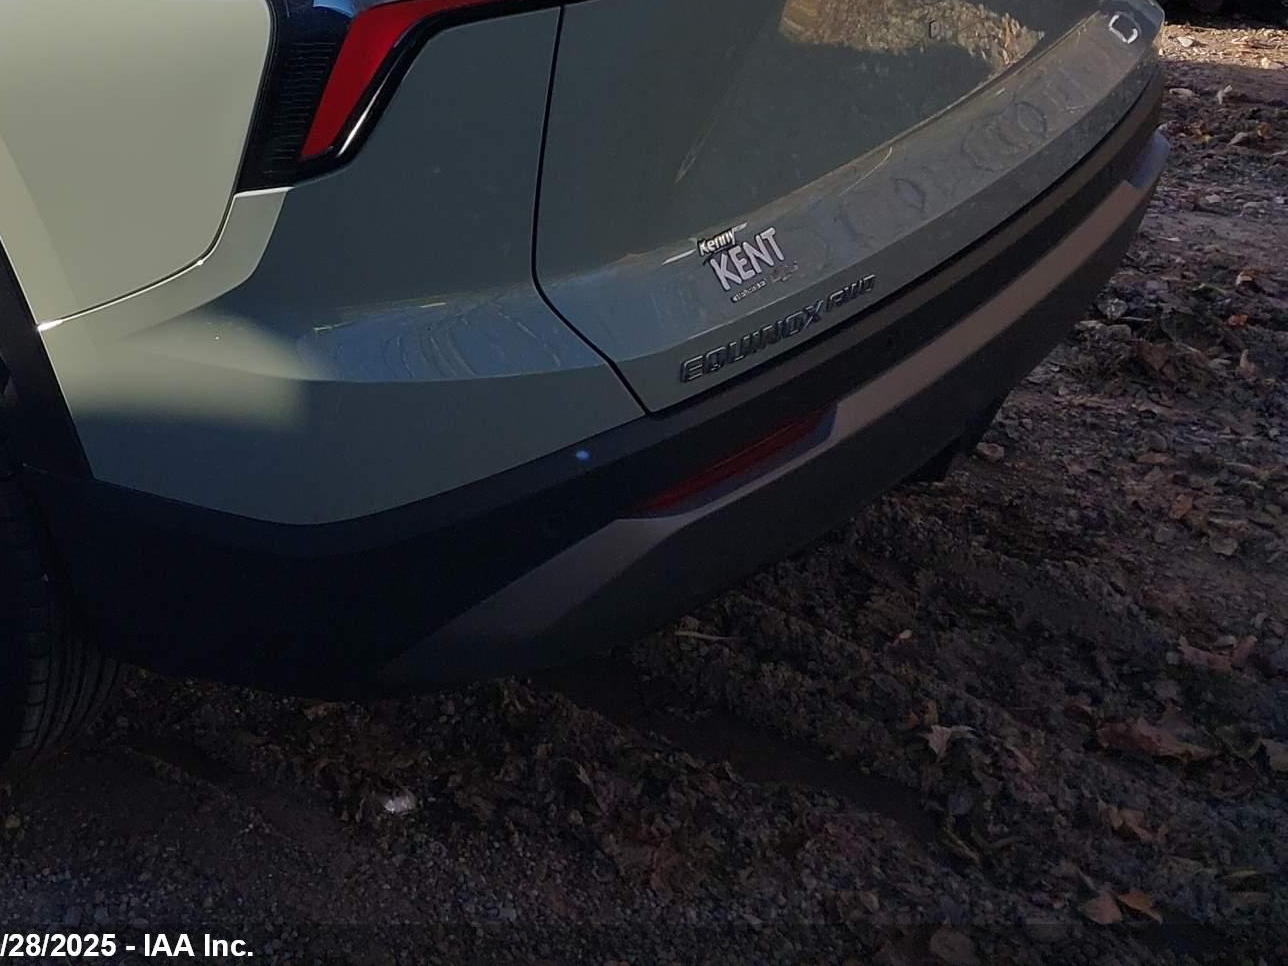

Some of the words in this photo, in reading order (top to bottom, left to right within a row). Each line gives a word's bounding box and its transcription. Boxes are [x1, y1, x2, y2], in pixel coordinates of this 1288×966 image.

[698, 226, 736, 256] Kenny
[710, 227, 785, 291] KENT
[680, 298, 825, 382] EQUINOX
